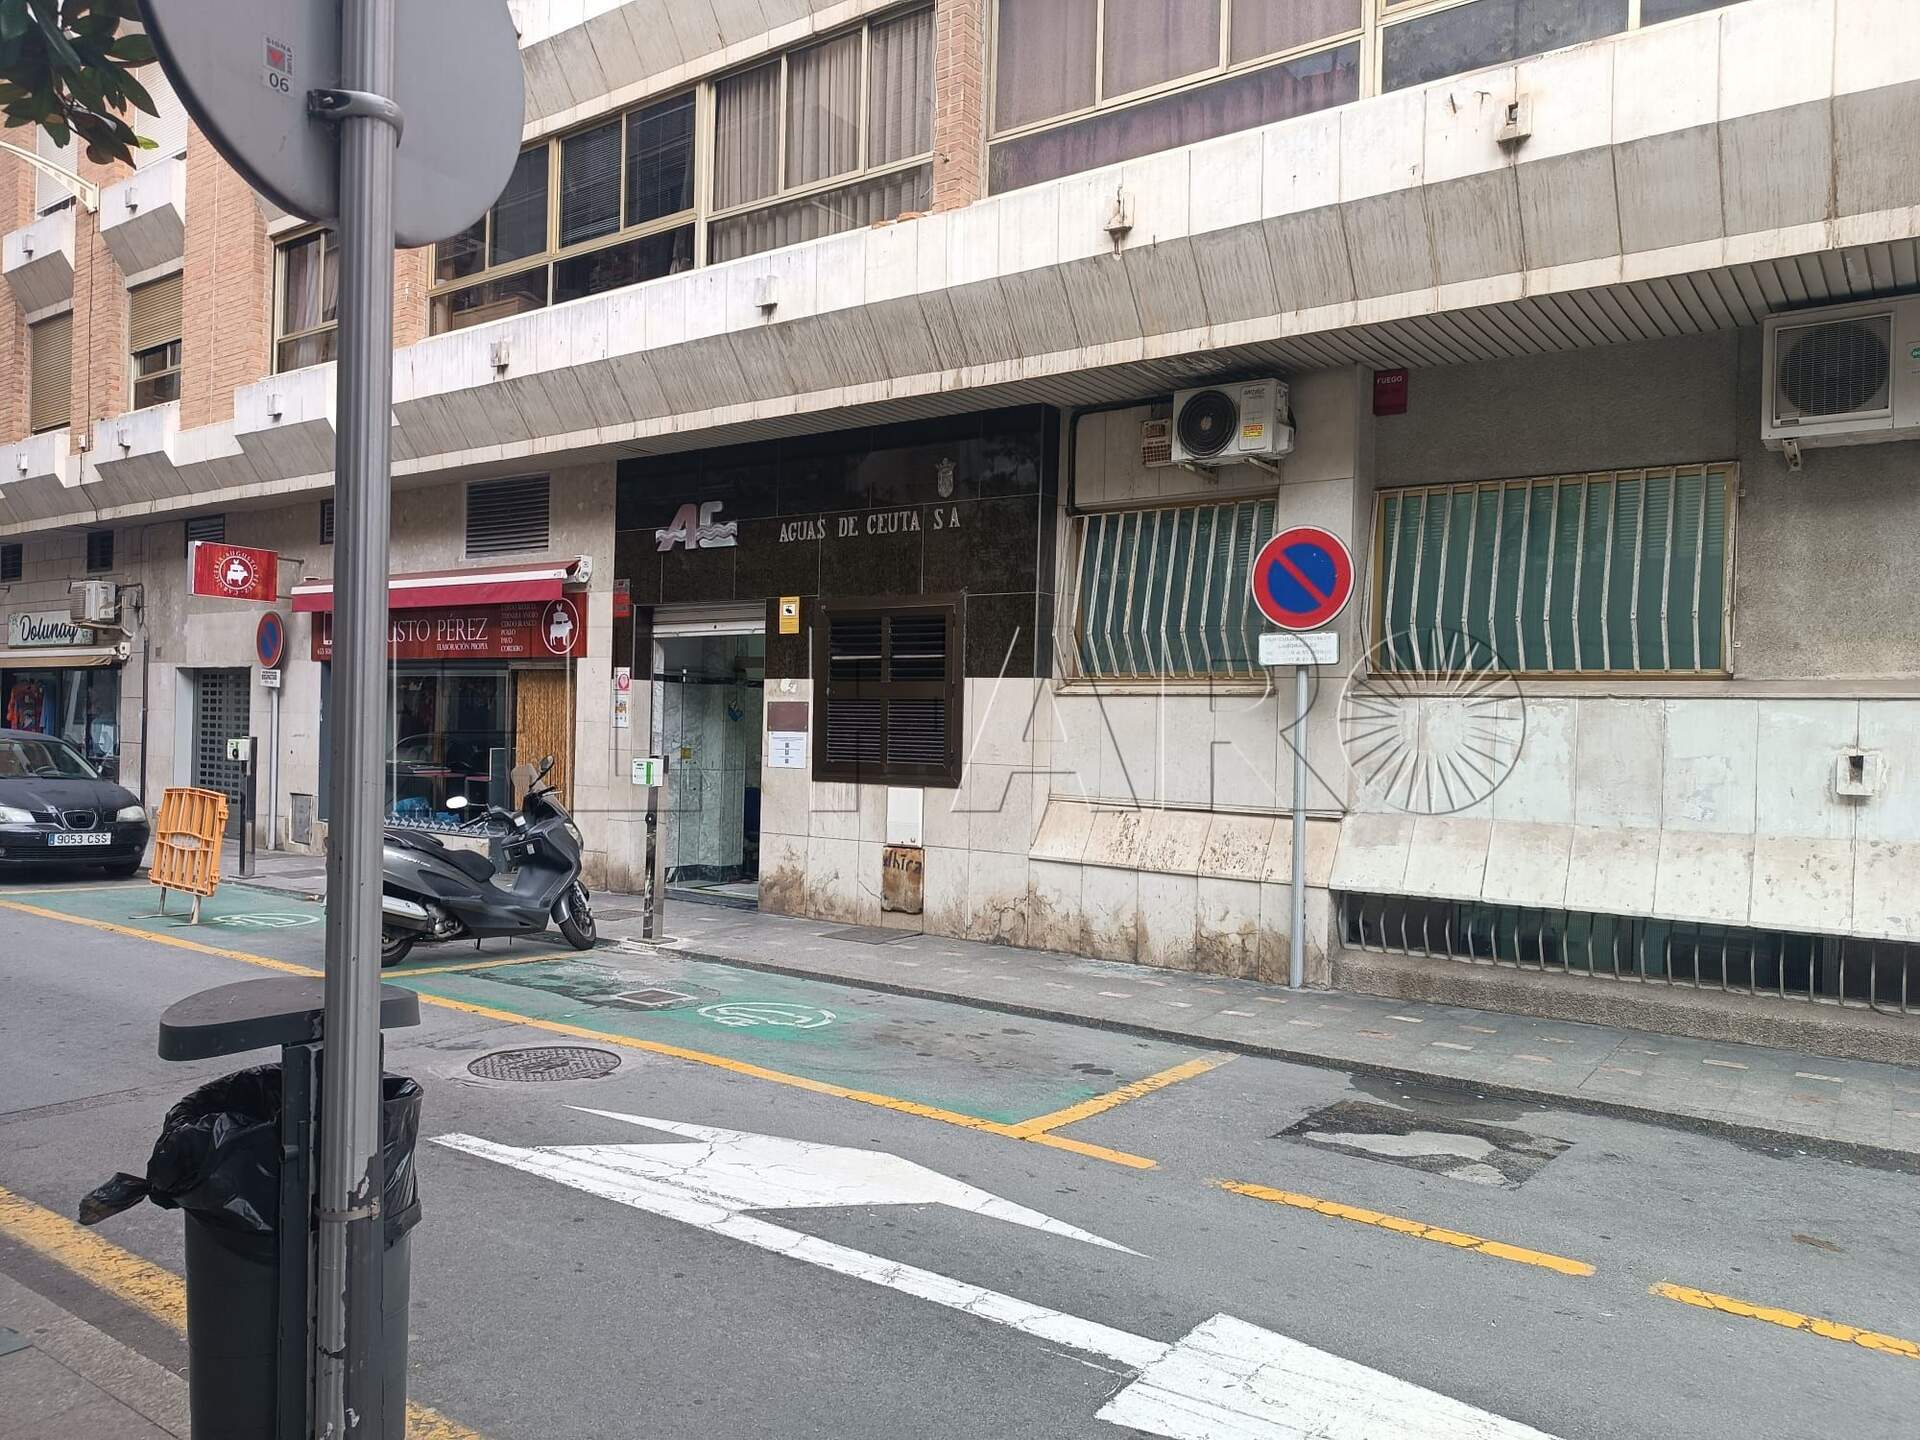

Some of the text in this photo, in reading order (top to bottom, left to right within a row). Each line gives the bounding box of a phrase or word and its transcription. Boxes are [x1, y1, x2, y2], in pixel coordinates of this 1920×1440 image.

[269, 73, 290, 93] 06
[779, 519, 826, 543] AGUAS
[838, 516, 859, 538] DE
[866, 510, 921, 535] CEUTA
[386, 613, 489, 643] USTO PÉREZ
[57, 833, 108, 845] 9053 CSS
